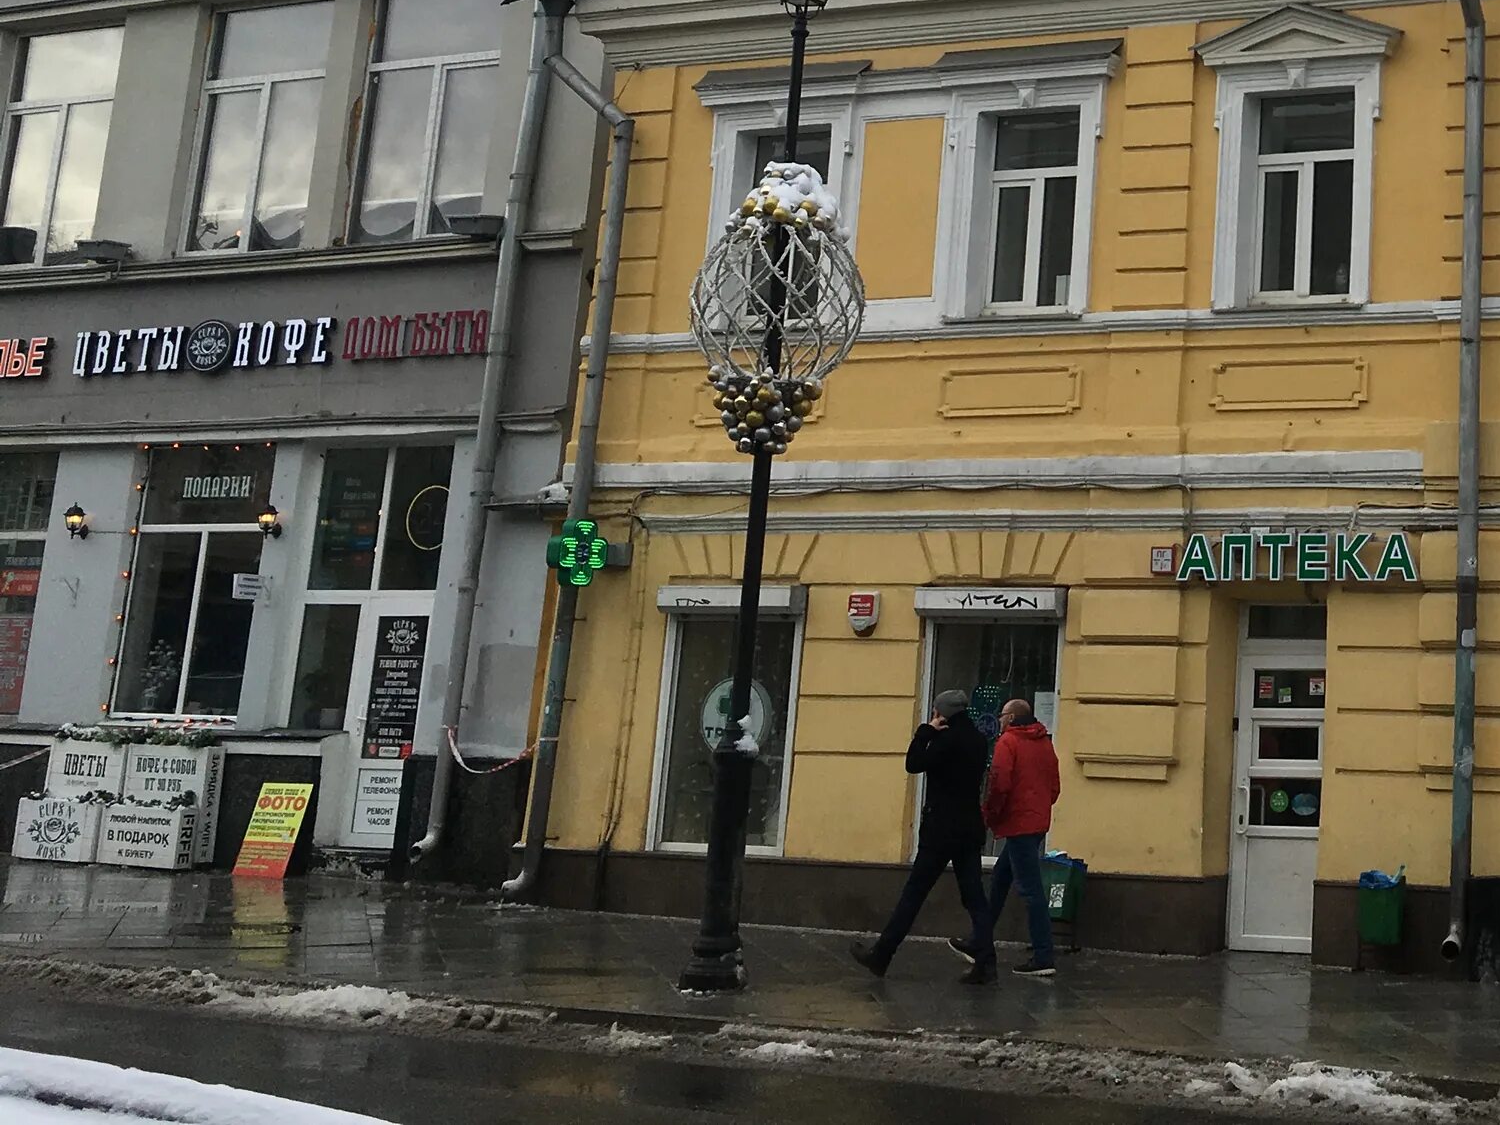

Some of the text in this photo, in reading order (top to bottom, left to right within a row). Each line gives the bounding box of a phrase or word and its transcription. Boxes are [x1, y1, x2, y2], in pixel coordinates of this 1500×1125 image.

[342, 310, 490, 359] ДОМ БЫТА
[73, 317, 331, 376] ЦВЕТЫ КОФЕ
[183, 476, 251, 498] ПОДАРКИ
[1176, 533, 1417, 581] АПТЕКА
[64, 753, 108, 777] ЦВЕТЫ
[136, 757, 197, 775] КОФЕ С СОБОЙ
[144, 777, 155, 790] ОТ
[370, 776, 398, 784] РЕМОНТ
[258, 795, 306, 811] ФОТО
[366, 807, 394, 815] РЕМОНТ
[110, 814, 171, 826] ЛЮБОЙ НАПИТОК
[367, 818, 391, 826] ЧАСОВ
[107, 830, 169, 845] В ПОДАРОК
[125, 849, 154, 859] БУКЕТУ
